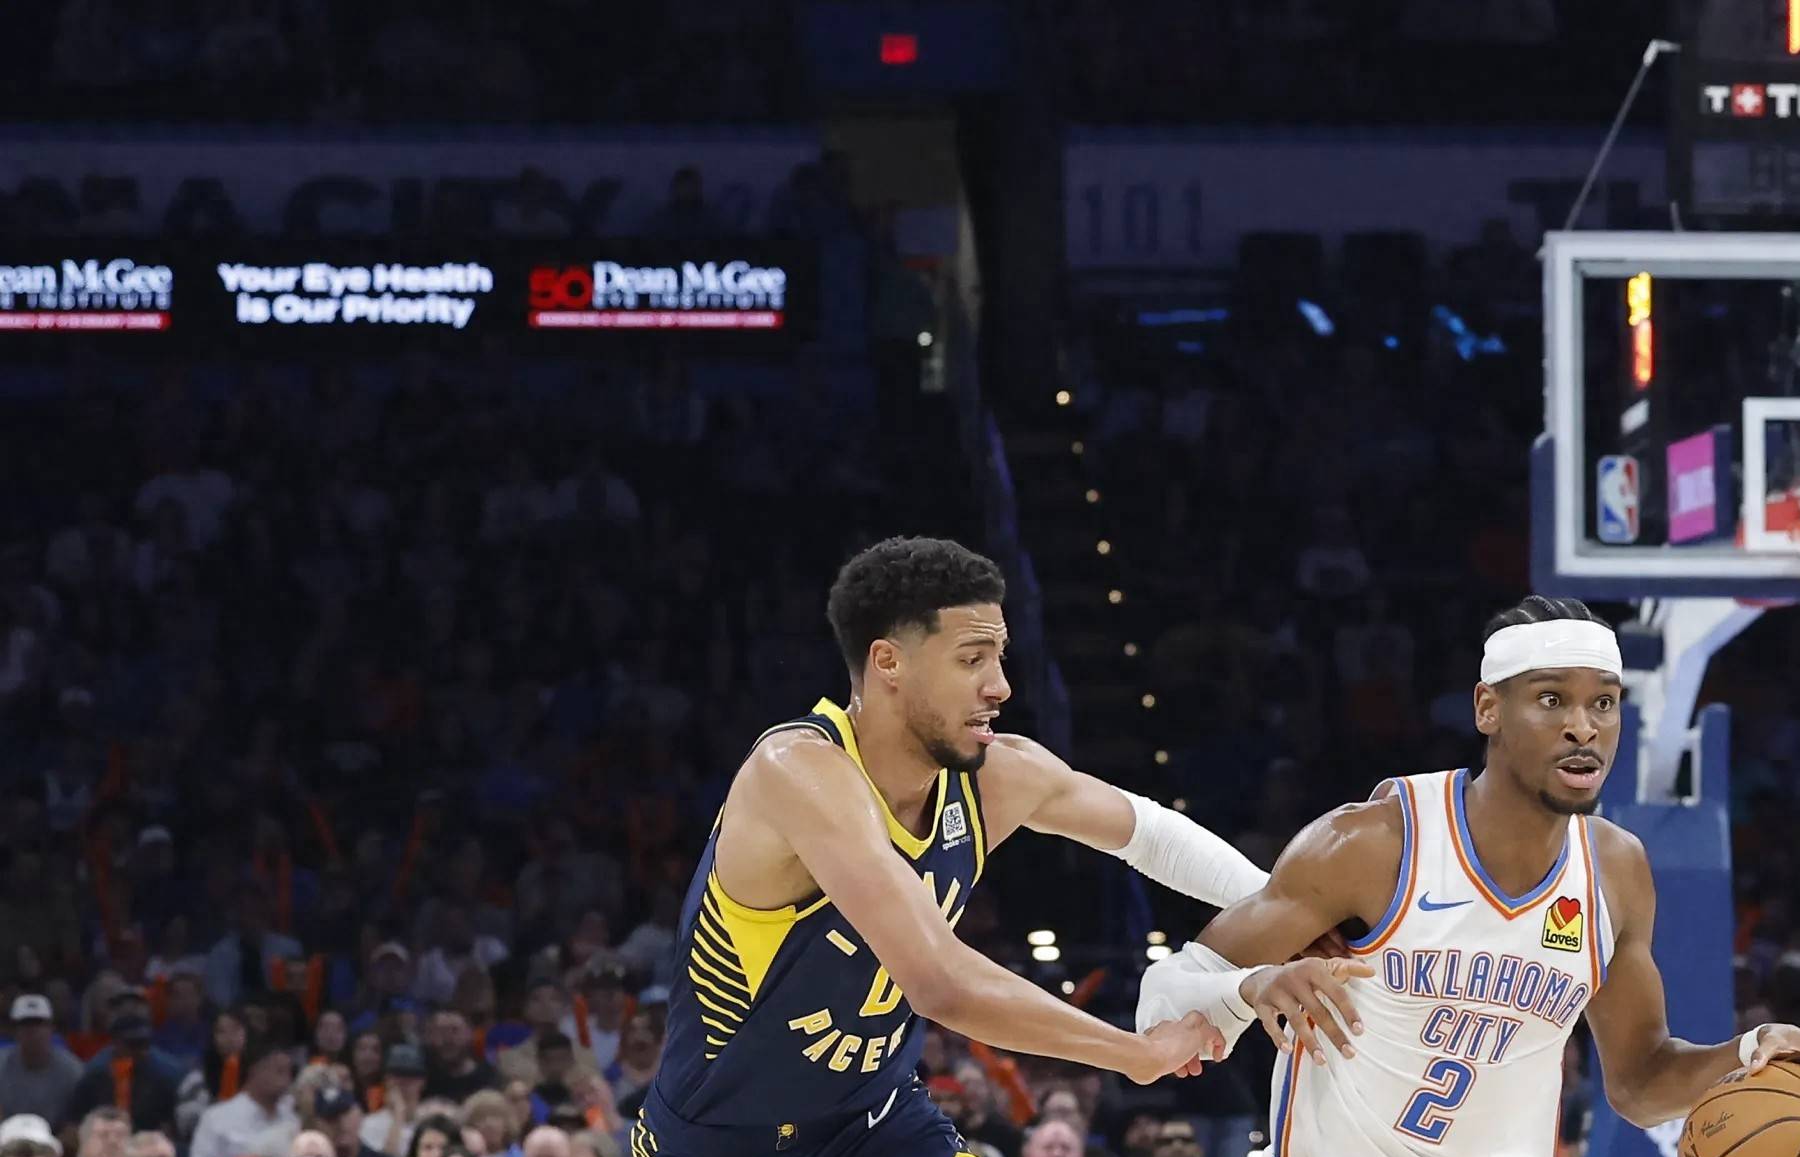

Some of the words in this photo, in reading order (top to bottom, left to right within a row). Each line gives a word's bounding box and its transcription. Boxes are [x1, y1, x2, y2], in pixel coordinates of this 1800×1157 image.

[61, 258, 173, 294] McGee
[216, 262, 299, 292] Your
[302, 262, 372, 297] Eye
[372, 262, 494, 293] Health
[529, 265, 593, 308] 50
[593, 260, 679, 294] Dean
[682, 260, 787, 295] McGee
[272, 293, 341, 324] Our
[341, 292, 476, 329] Priority
[1544, 927, 1580, 949] Love's
[1383, 947, 1590, 1029] OKLAHOMA
[1420, 1004, 1524, 1065] CITY
[1393, 1055, 1478, 1146] 2
